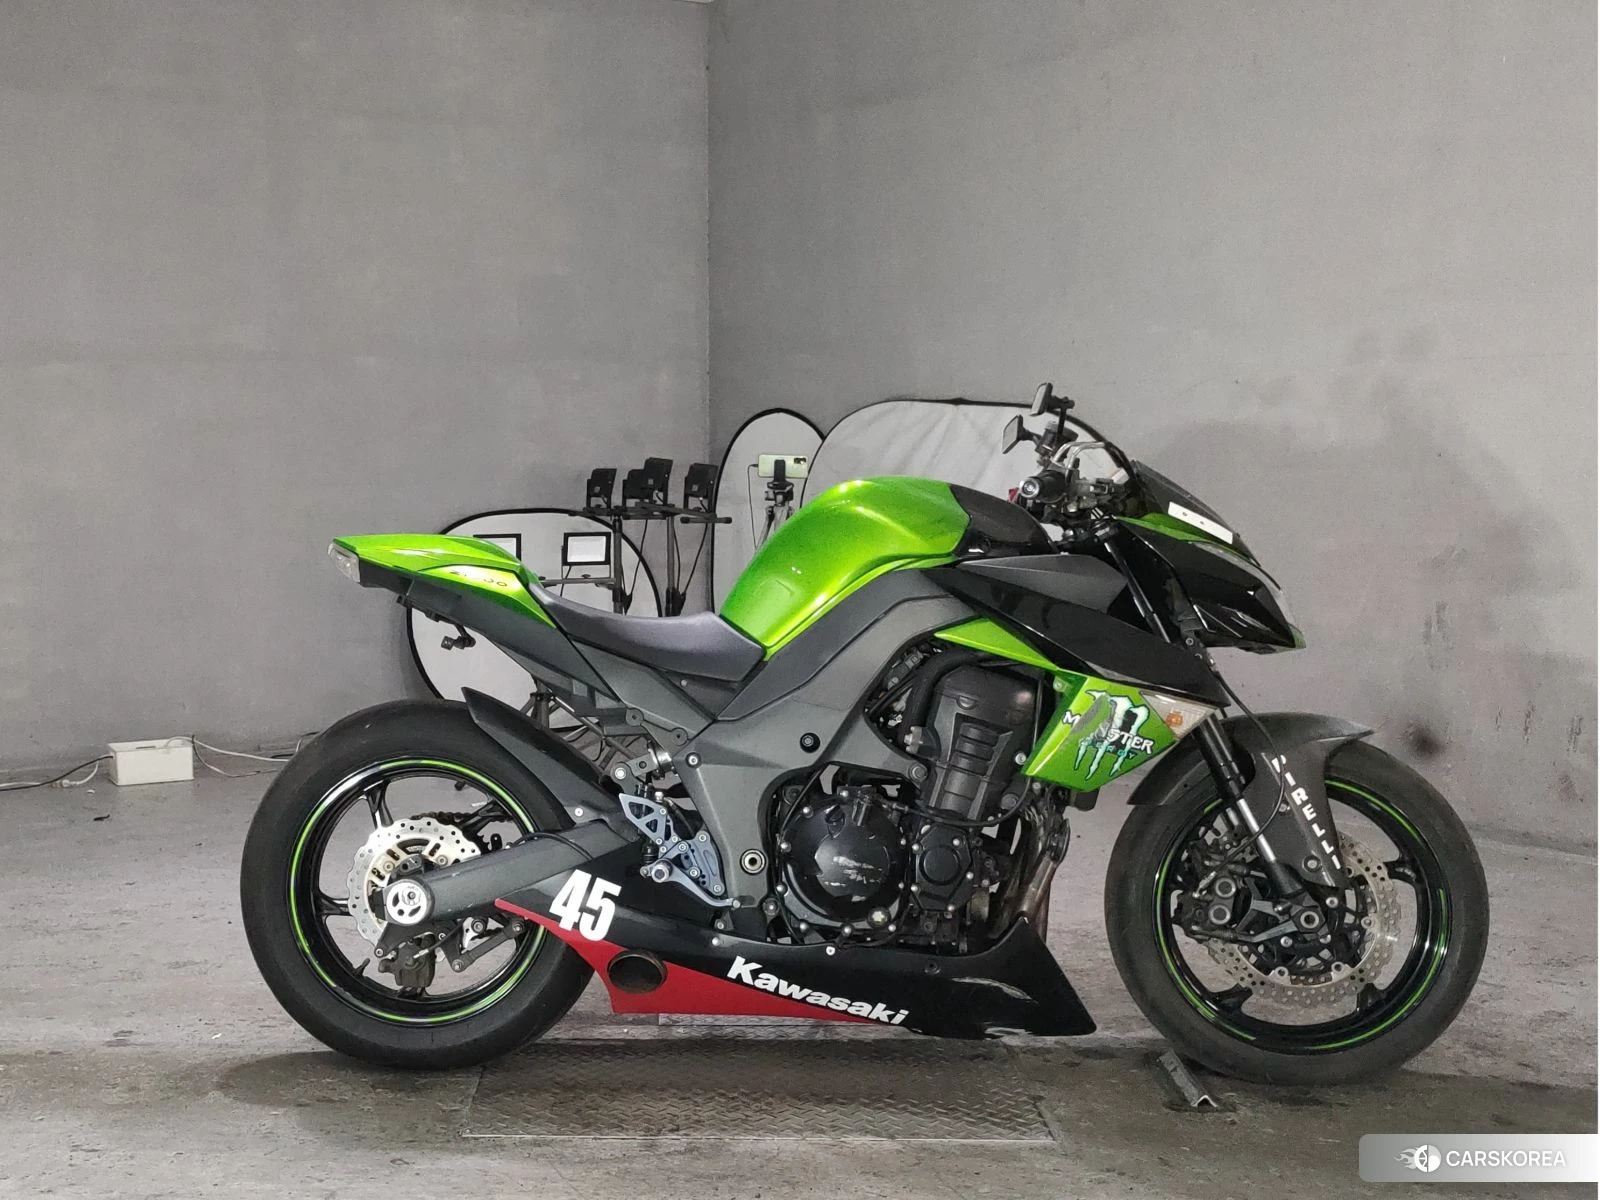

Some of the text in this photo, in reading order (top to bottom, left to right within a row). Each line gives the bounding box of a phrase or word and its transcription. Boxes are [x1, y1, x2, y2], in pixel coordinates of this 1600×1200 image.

[1271, 755, 1341, 870] PIRELLI
[549, 869, 622, 941] 45
[727, 956, 909, 1026] Kawasaki
